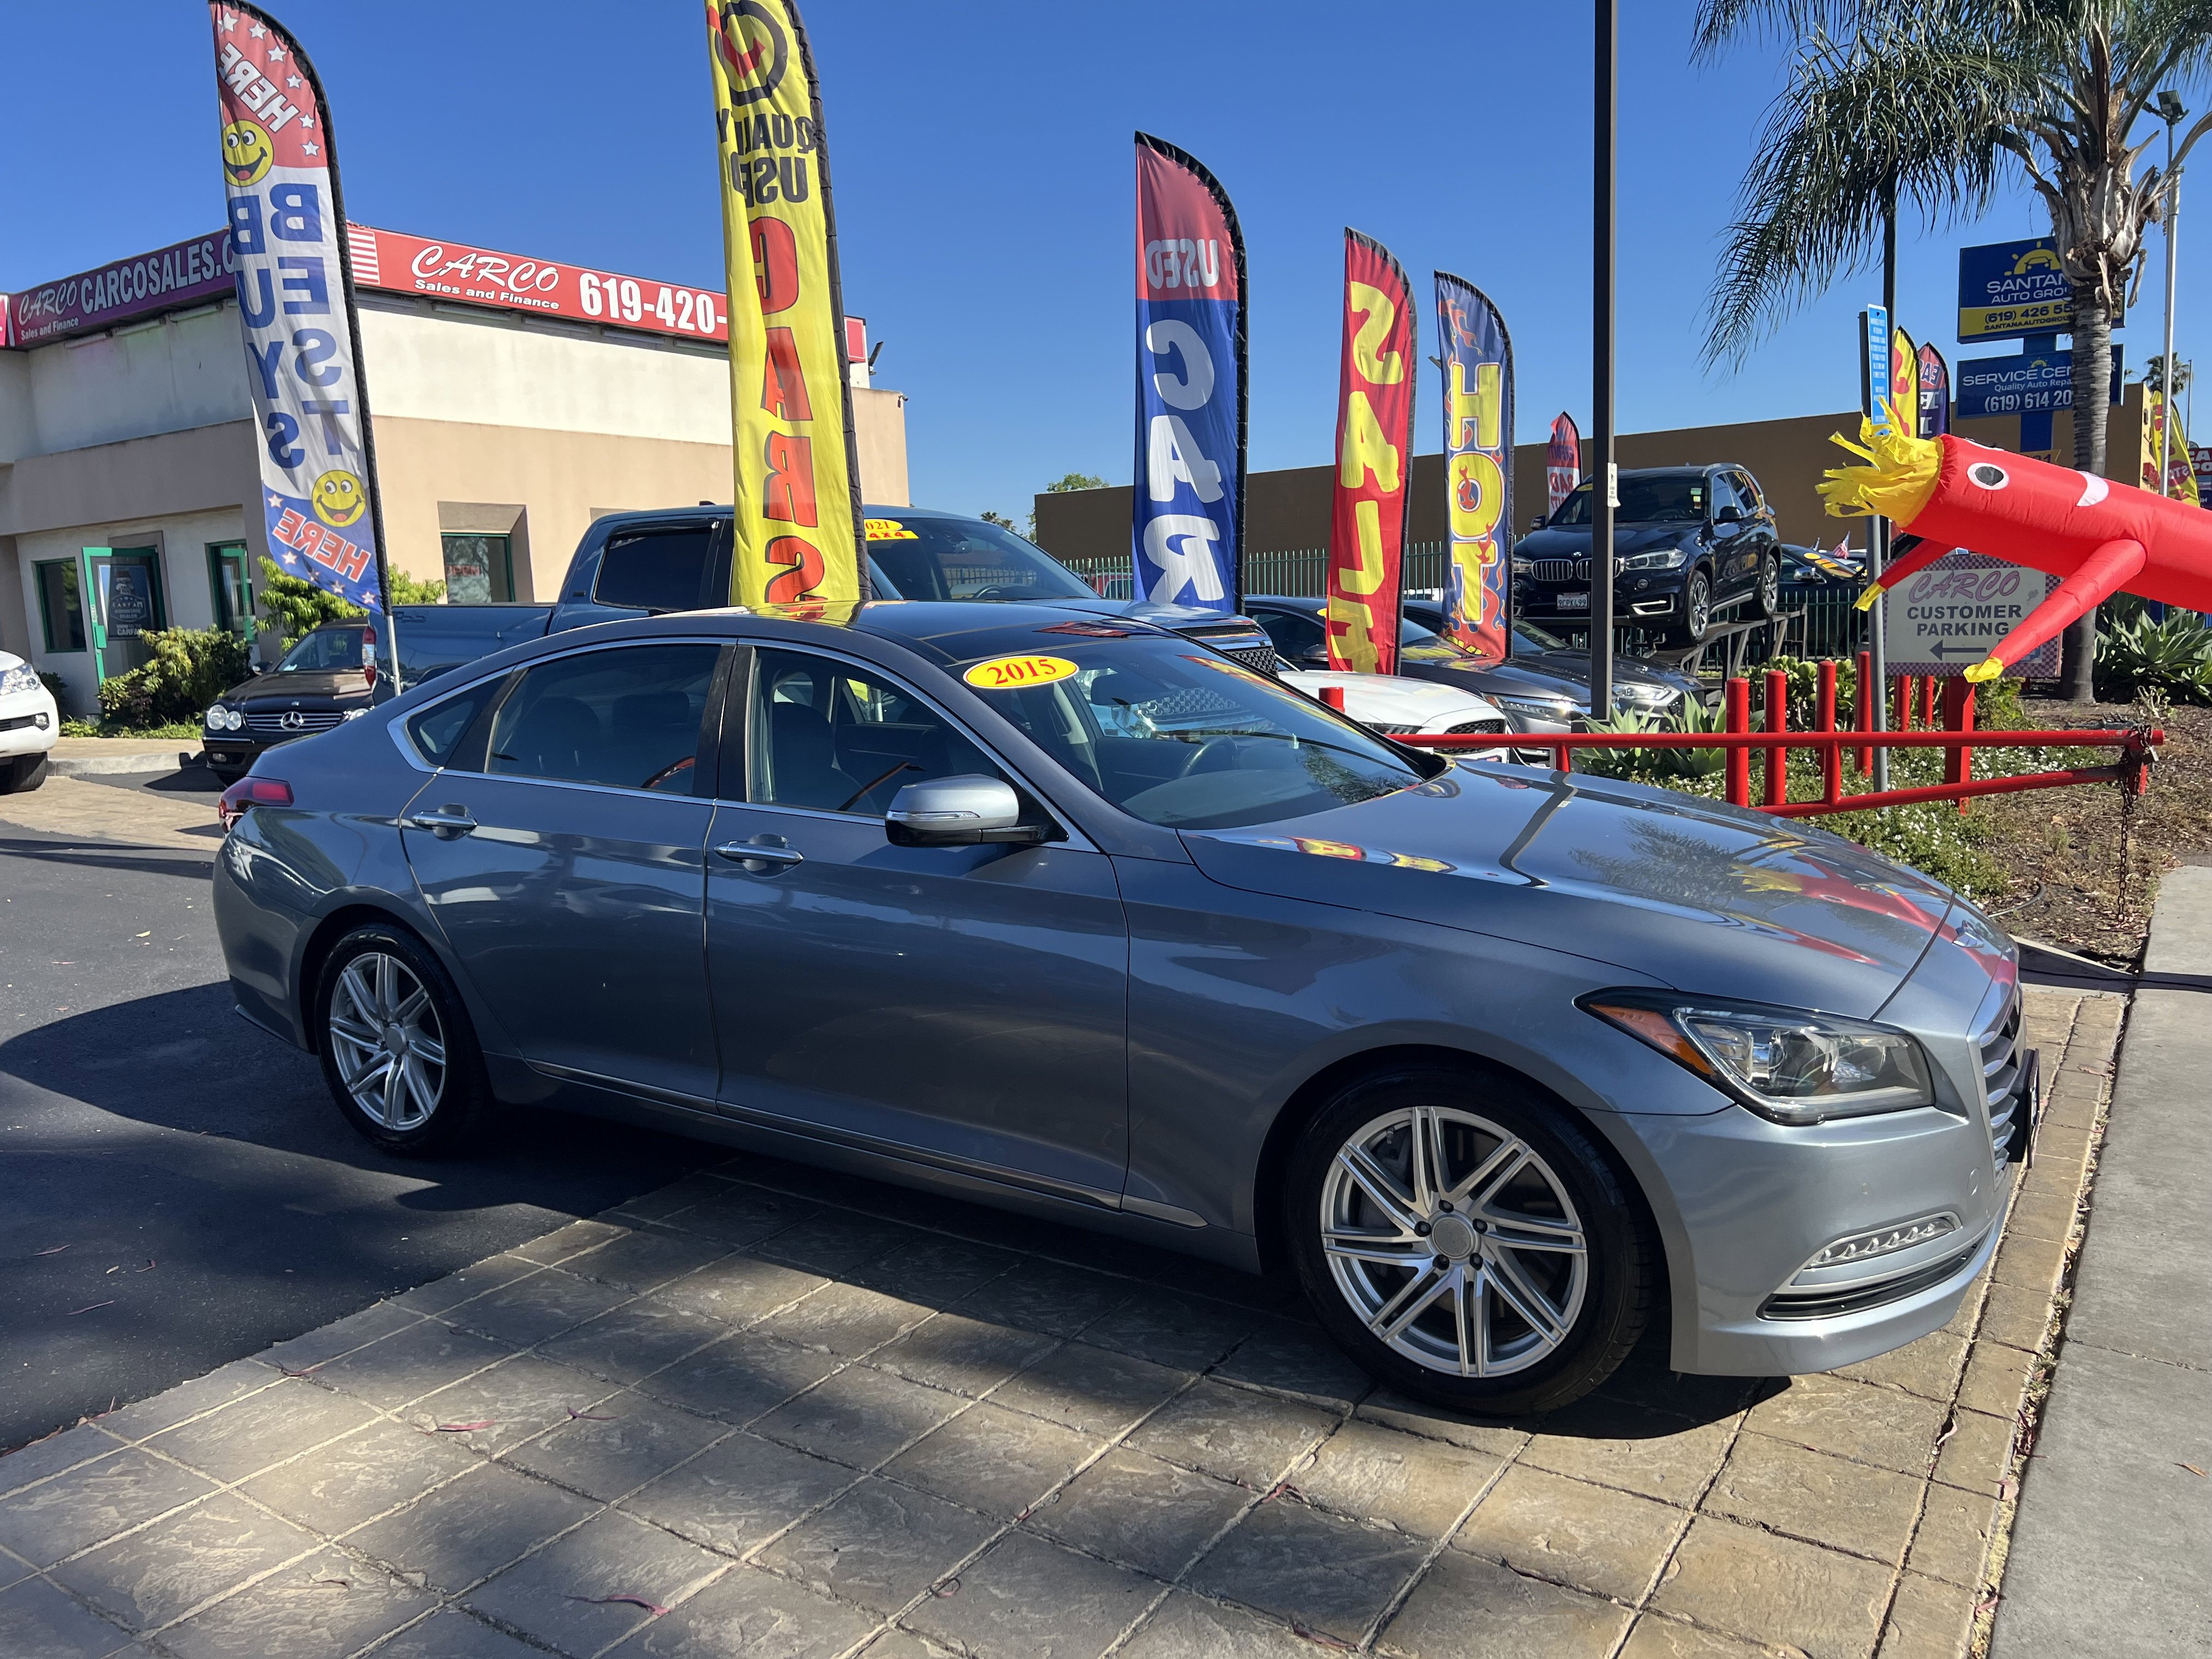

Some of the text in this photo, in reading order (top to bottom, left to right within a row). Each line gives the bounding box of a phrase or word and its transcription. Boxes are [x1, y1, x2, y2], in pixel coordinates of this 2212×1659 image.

[411, 245, 559, 293] CARCO
[18, 280, 77, 326] CARCO
[415, 279, 560, 311] Sales and Finance
[1991, 291, 2030, 304] AUTO
[1985, 310, 2017, 324] (619)
[2021, 306, 2050, 318] 426
[21, 317, 79, 341] Sales and Finance
[1963, 369, 2038, 386] SERVICE
[1994, 383, 2025, 393] Quality
[1984, 394, 2020, 412] (619)
[2025, 391, 2050, 409] 614
[865, 521, 890, 530] 021
[1909, 571, 2021, 603] CARCO
[1907, 605, 2022, 619] CUSTOMER
[1917, 622, 2009, 636] PARKING
[987, 659, 1057, 685] 2015
